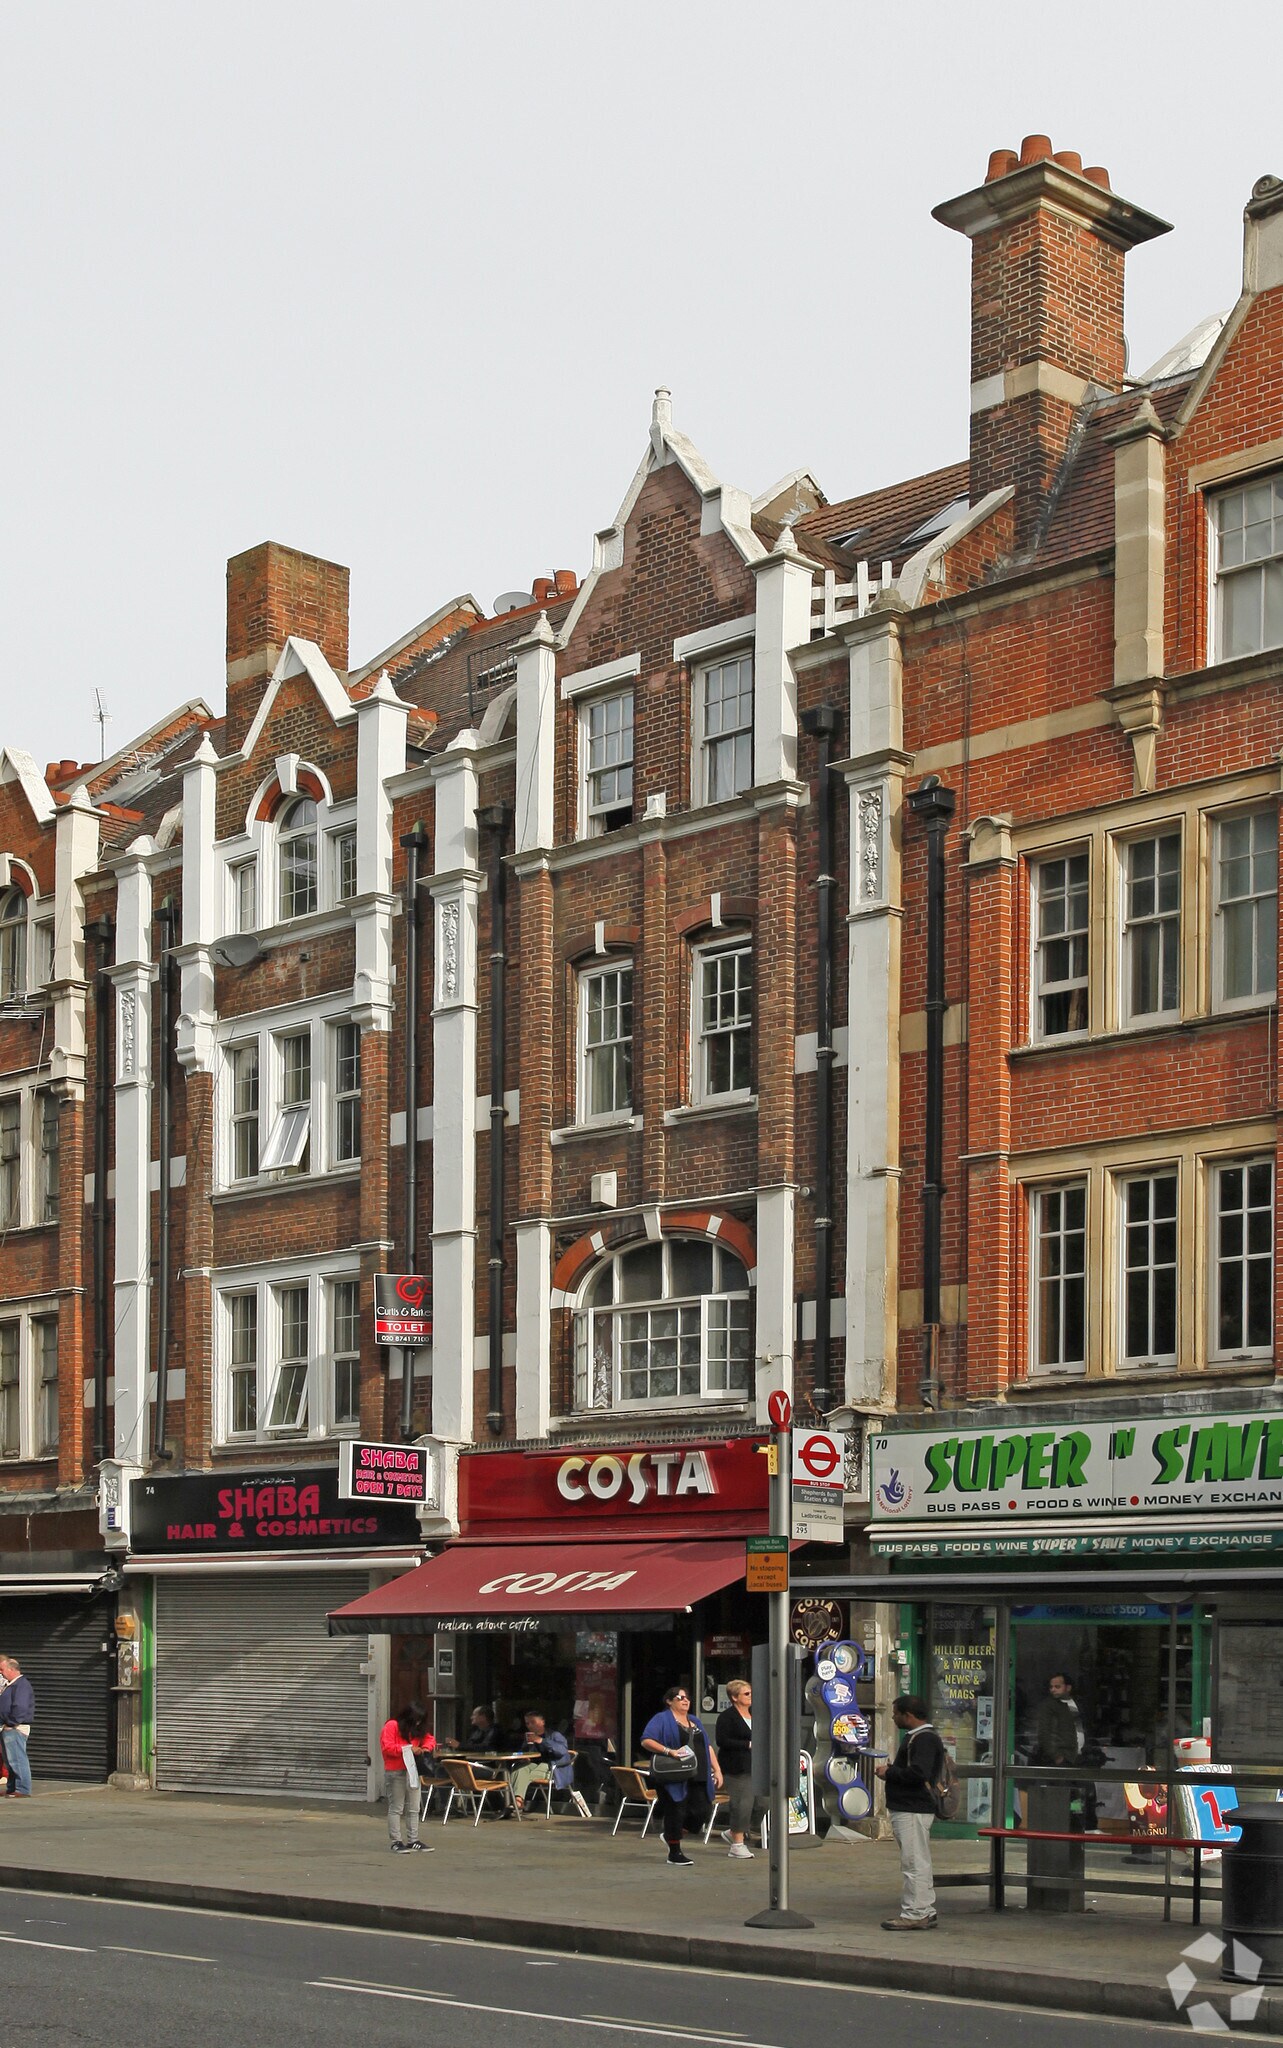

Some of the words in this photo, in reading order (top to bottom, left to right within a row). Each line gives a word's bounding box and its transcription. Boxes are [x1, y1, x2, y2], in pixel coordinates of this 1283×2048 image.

[376, 1306, 400, 1316] Curtis
[400, 1307, 409, 1317] &
[410, 1307, 432, 1317] Parke
[386, 1323, 402, 1331] TO
[404, 1323, 425, 1332] LET
[775, 1396, 788, 1422] Y
[875, 1439, 888, 1450] 70
[360, 1448, 419, 1471] SHABA
[923, 1430, 1092, 1494] SUPER
[1151, 1418, 1283, 1485] SAVE
[355, 1468, 376, 1480] HAIR
[383, 1471, 423, 1484] COSMETICS
[557, 1450, 719, 1504] COSTA
[145, 1486, 155, 1495] 74
[356, 1480, 384, 1494] OPEN
[387, 1483, 394, 1495] 7
[396, 1484, 423, 1497] DAYS
[217, 1484, 320, 1521] SHABA
[803, 1495, 821, 1503] Station
[879, 1500, 902, 1514] National
[900, 1488, 913, 1510] Lottery
[927, 1504, 956, 1513] BUS
[961, 1501, 1001, 1512] PASS
[1026, 1499, 1069, 1510] FOOD
[1072, 1498, 1083, 1508] &
[1087, 1497, 1127, 1507] WINE
[1144, 1494, 1204, 1505] MONEY
[1210, 1491, 1283, 1503] EXCHAN
[801, 1512, 822, 1520] Ladbroke
[823, 1513, 837, 1521] Grove
[166, 1523, 217, 1540] HAIR
[227, 1522, 245, 1538] &
[255, 1517, 378, 1537] COSMETICS
[796, 1526, 808, 1534] 295
[878, 1544, 903, 1553] BUS
[905, 1543, 938, 1552] PASS
[944, 1543, 981, 1552] FOOD
[982, 1542, 991, 1551] &
[995, 1541, 1028, 1551] WINE
[1032, 1538, 1078, 1551] SUPER
[1092, 1536, 1128, 1550] SAVE
[1131, 1537, 1185, 1547] MONEY
[1189, 1534, 1273, 1545] EXCHANGE
[478, 1570, 638, 1594] COSTA
[797, 1599, 834, 1613] COSTA
[1119, 1605, 1146, 1616] Stop
[437, 1617, 474, 1631] Italian
[476, 1617, 507, 1631] about
[508, 1616, 540, 1632] coffee
[934, 1645, 965, 1656] HILLED
[968, 1645, 996, 1657] BEERS
[943, 1660, 950, 1670] &
[952, 1660, 982, 1670] WINES
[944, 1674, 971, 1685] NEWS
[973, 1674, 980, 1685] &
[949, 1689, 975, 1700] MAGS
